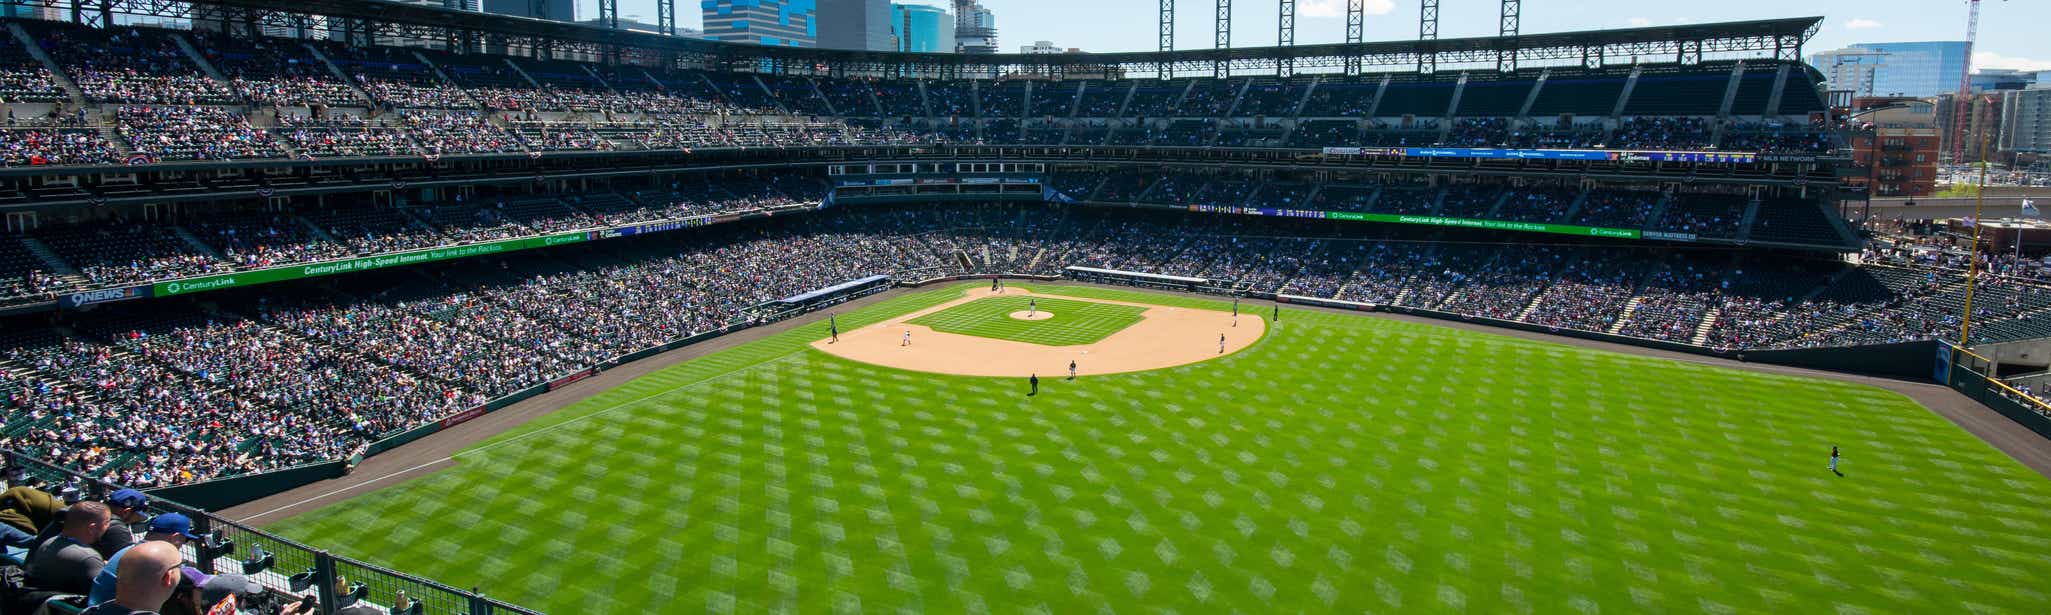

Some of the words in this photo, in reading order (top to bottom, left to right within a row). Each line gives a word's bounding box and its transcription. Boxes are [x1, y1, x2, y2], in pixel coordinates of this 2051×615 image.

[304, 262, 353, 275] CenturyLink
[354, 256, 399, 269] High-Speed
[183, 277, 234, 290] CenturyLink
[72, 288, 125, 307] 9NEWS
